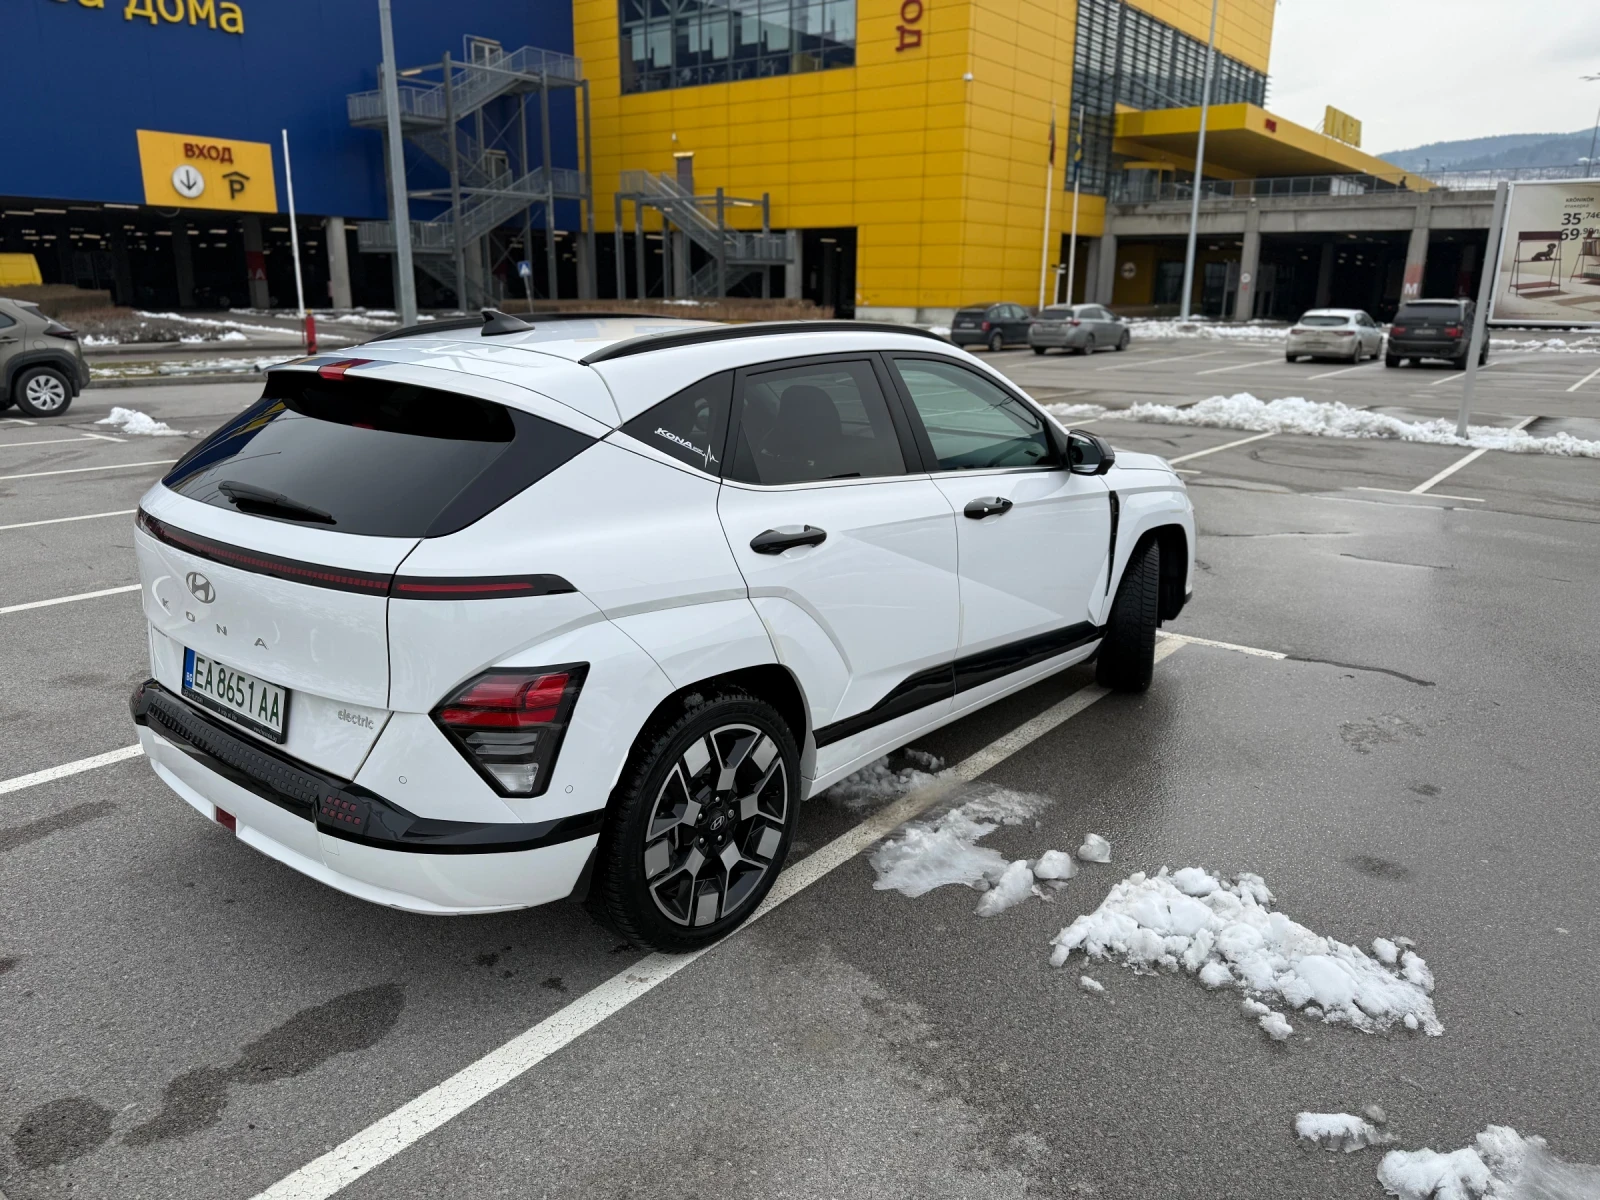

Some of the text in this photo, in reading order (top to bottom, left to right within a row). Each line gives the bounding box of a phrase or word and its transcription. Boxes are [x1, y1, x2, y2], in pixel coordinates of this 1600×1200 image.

[183, 142, 234, 165] ВХОД
[161, 597, 270, 651] KONA
[337, 708, 374, 730] electric
